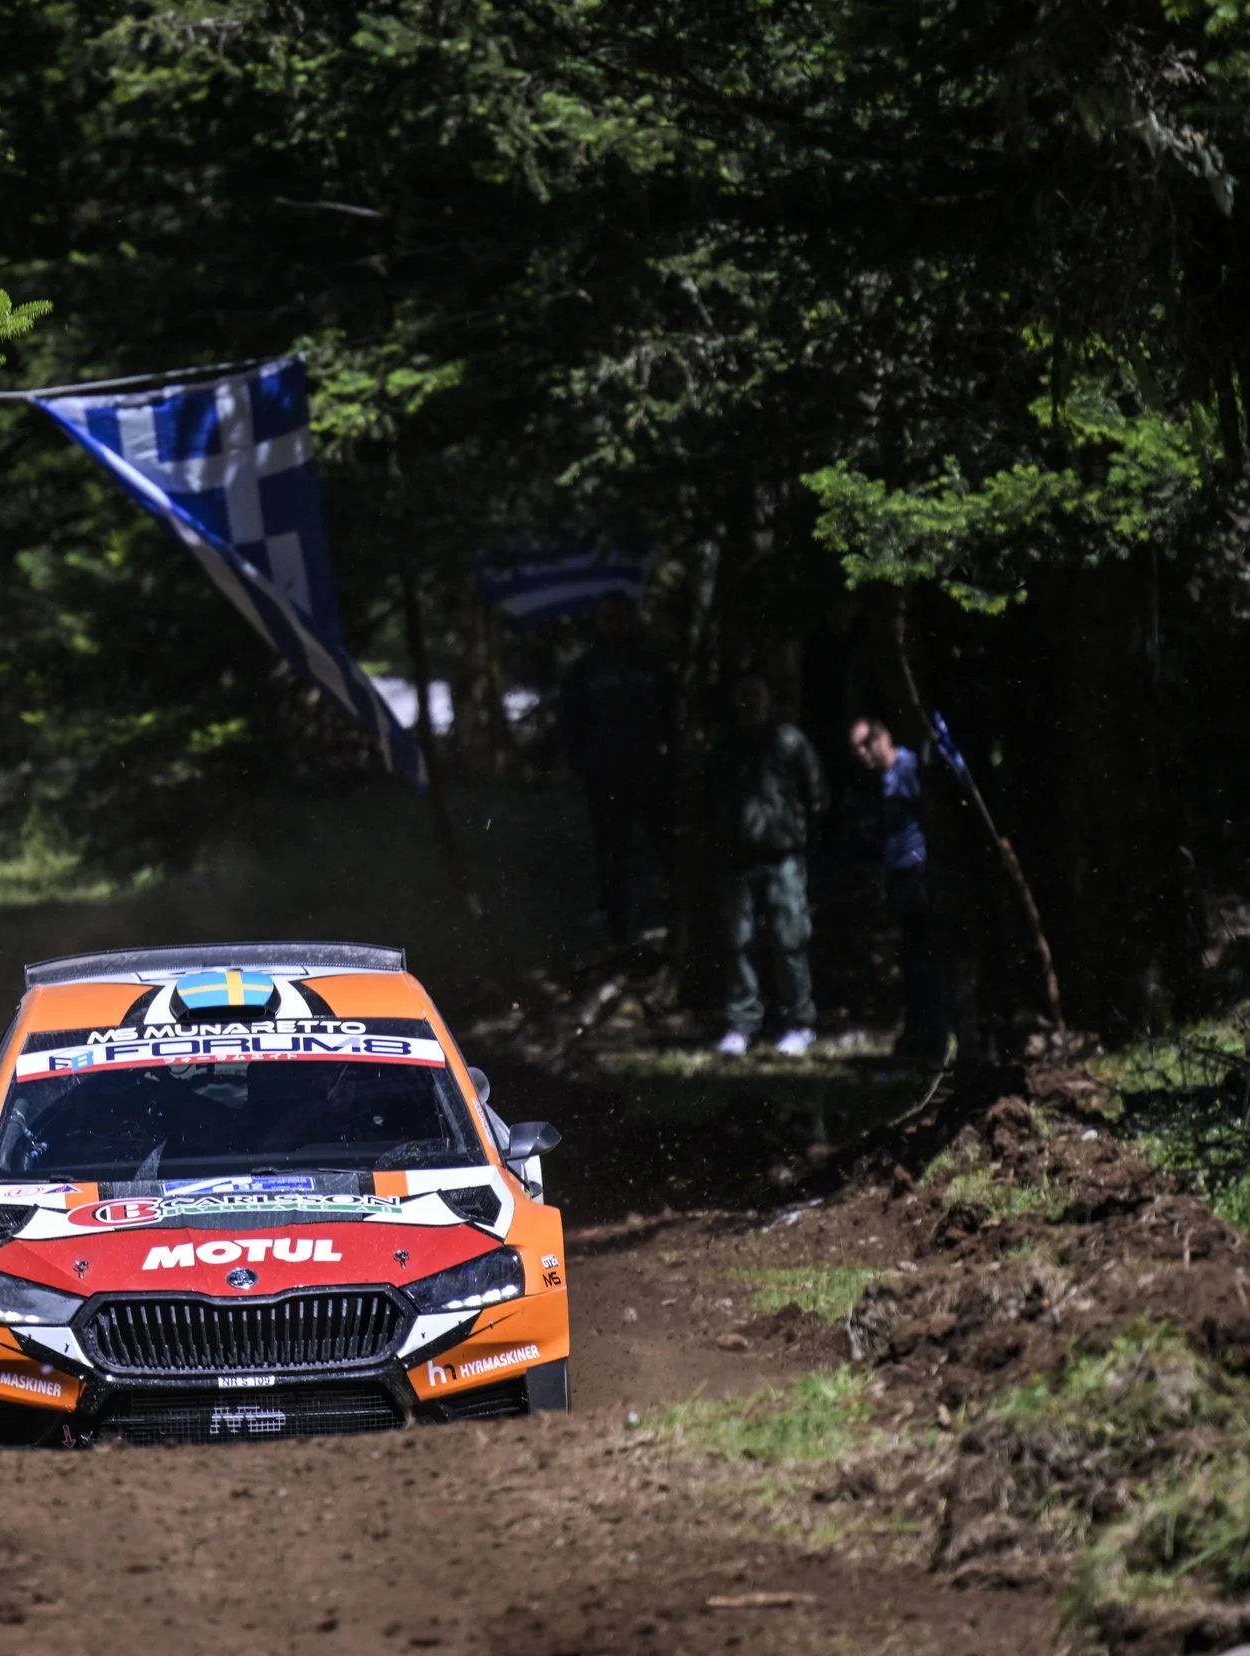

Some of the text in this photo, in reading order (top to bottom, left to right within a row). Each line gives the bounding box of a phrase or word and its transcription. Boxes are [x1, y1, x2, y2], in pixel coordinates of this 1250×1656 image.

[87, 1020, 366, 1044] MS MUNARETTO
[105, 1036, 411, 1061] FORUM8
[160, 1193, 401, 1209] CARLSSON
[141, 1238, 343, 1270] MOTUL
[459, 1344, 541, 1378] HYRMASKINER
